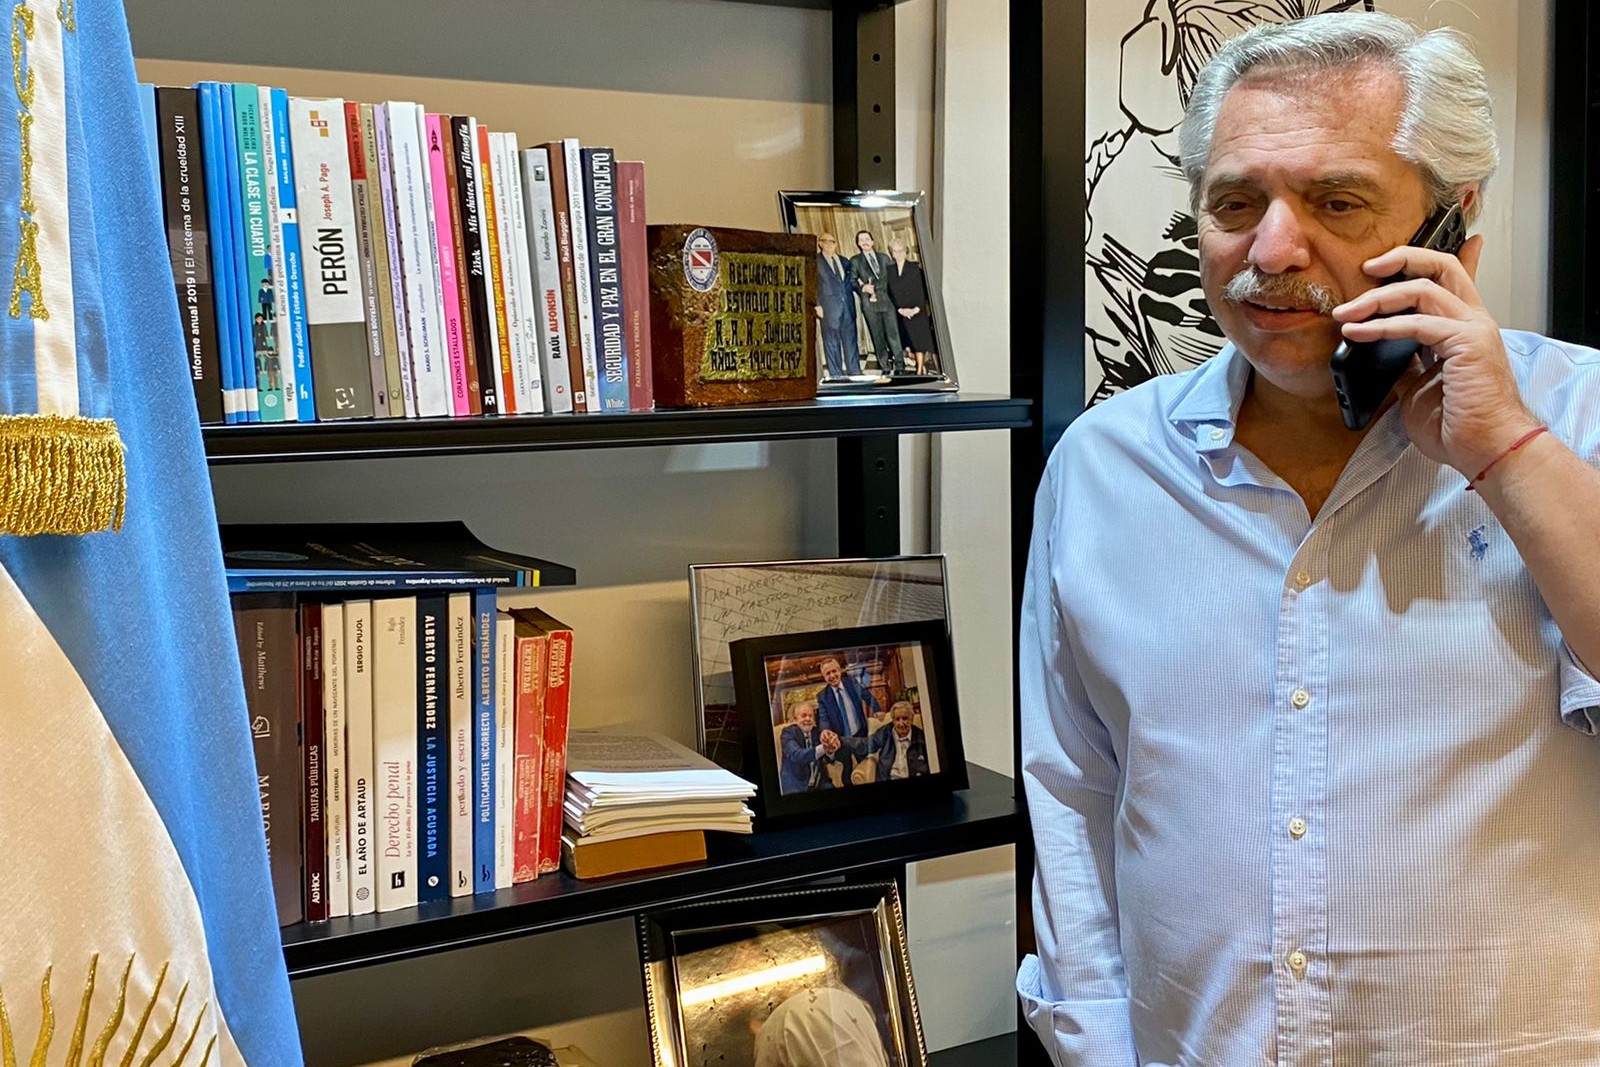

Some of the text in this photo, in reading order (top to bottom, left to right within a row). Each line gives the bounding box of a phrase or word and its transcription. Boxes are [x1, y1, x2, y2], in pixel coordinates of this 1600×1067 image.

[319, 163, 330, 182] Page
[459, 123, 478, 234] Mis chistes, mi filosofía
[244, 152, 265, 257] LA CLASE UN CUARTO
[269, 186, 279, 224] metafísica
[321, 194, 333, 221] Joseph
[272, 225, 280, 233] la
[272, 233, 281, 243] de
[559, 211, 570, 263] Raúl Biaggioni
[575, 210, 584, 251] dramaturgia
[175, 115, 203, 380] Informe anual 2019 El sistema de la crueldad XIII
[275, 243, 286, 279] problema
[314, 228, 346, 295] PERÓN
[542, 231, 551, 261] Eduardo
[577, 252, 585, 262] de
[289, 252, 298, 280] Derecho
[471, 250, 483, 276] Žižek
[592, 153, 622, 384] SEGURIDAD Y PAZ EN EL GRAN CONFLICTO
[729, 263, 802, 286] RECUERDO DEL
[291, 281, 298, 290] de
[579, 262, 588, 304] convocatoria
[279, 294, 287, 317] Lacan
[292, 291, 301, 314] Estado
[567, 283, 577, 347] Historias políticas
[726, 290, 802, 313] ESTADIO DE LA
[294, 321, 303, 347] Judicial
[545, 289, 561, 359] RAÚL ALFONSÍN
[297, 348, 305, 368] Poder
[450, 318, 464, 398] CORAZONES ESTALLADOS
[584, 333, 592, 364] identidad
[711, 347, 738, 371] AÑOS
[605, 397, 624, 408] White
[256, 640, 264, 649] by
[356, 645, 364, 673] SERGIO
[455, 617, 464, 700] Alberto Fernández
[480, 613, 490, 706] ALBERTO FERNÁNDEZ
[559, 640, 567, 667] JUICIO
[257, 651, 267, 690] Matthews
[425, 615, 437, 729] ALBERTO FERNÁNDEZ
[523, 643, 532, 694] IMPUNIDAD
[550, 638, 559, 689] IMPUNIDAD
[559, 666, 565, 674] A
[332, 710, 338, 718] UN
[333, 718, 338, 727] DE
[457, 729, 465, 762] escrito
[309, 745, 319, 822] TARIFAS PÚBLICAS
[481, 712, 490, 822] POLÍTICAMENTE INCORRECTO
[258, 774, 270, 832] MARIO
[384, 761, 404, 857] Derecho penal
[426, 737, 437, 857] LA JUSTICIA ACUSADA
[335, 836, 341, 844] EL
[357, 778, 367, 875] EL AÑO DE ARTAUD
